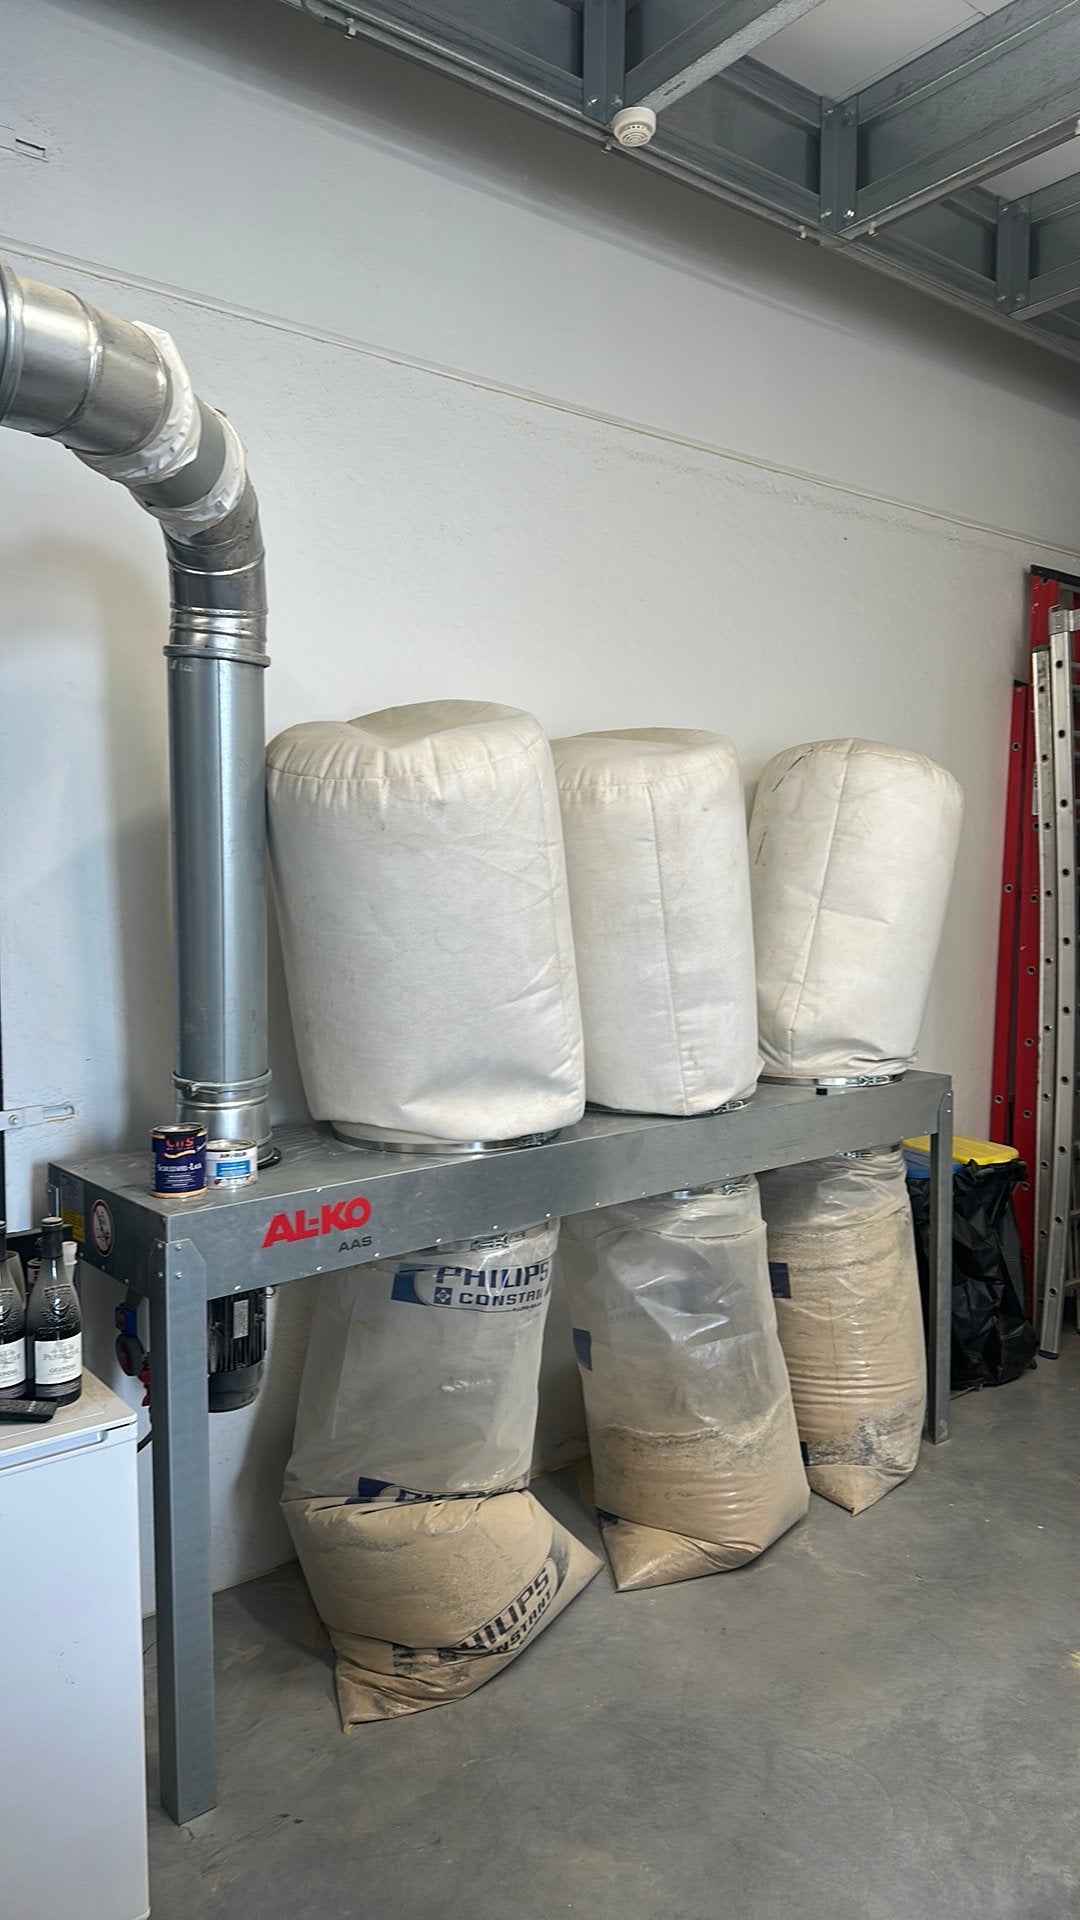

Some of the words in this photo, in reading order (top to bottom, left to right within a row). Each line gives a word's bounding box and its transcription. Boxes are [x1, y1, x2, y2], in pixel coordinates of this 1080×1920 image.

[262, 1197, 372, 1248] AL-KO
[338, 1236, 373, 1253] AAS
[435, 1260, 550, 1288] PHILIPS
[459, 1289, 544, 1307] CONSTAN
[459, 1567, 550, 1649] HILIPS
